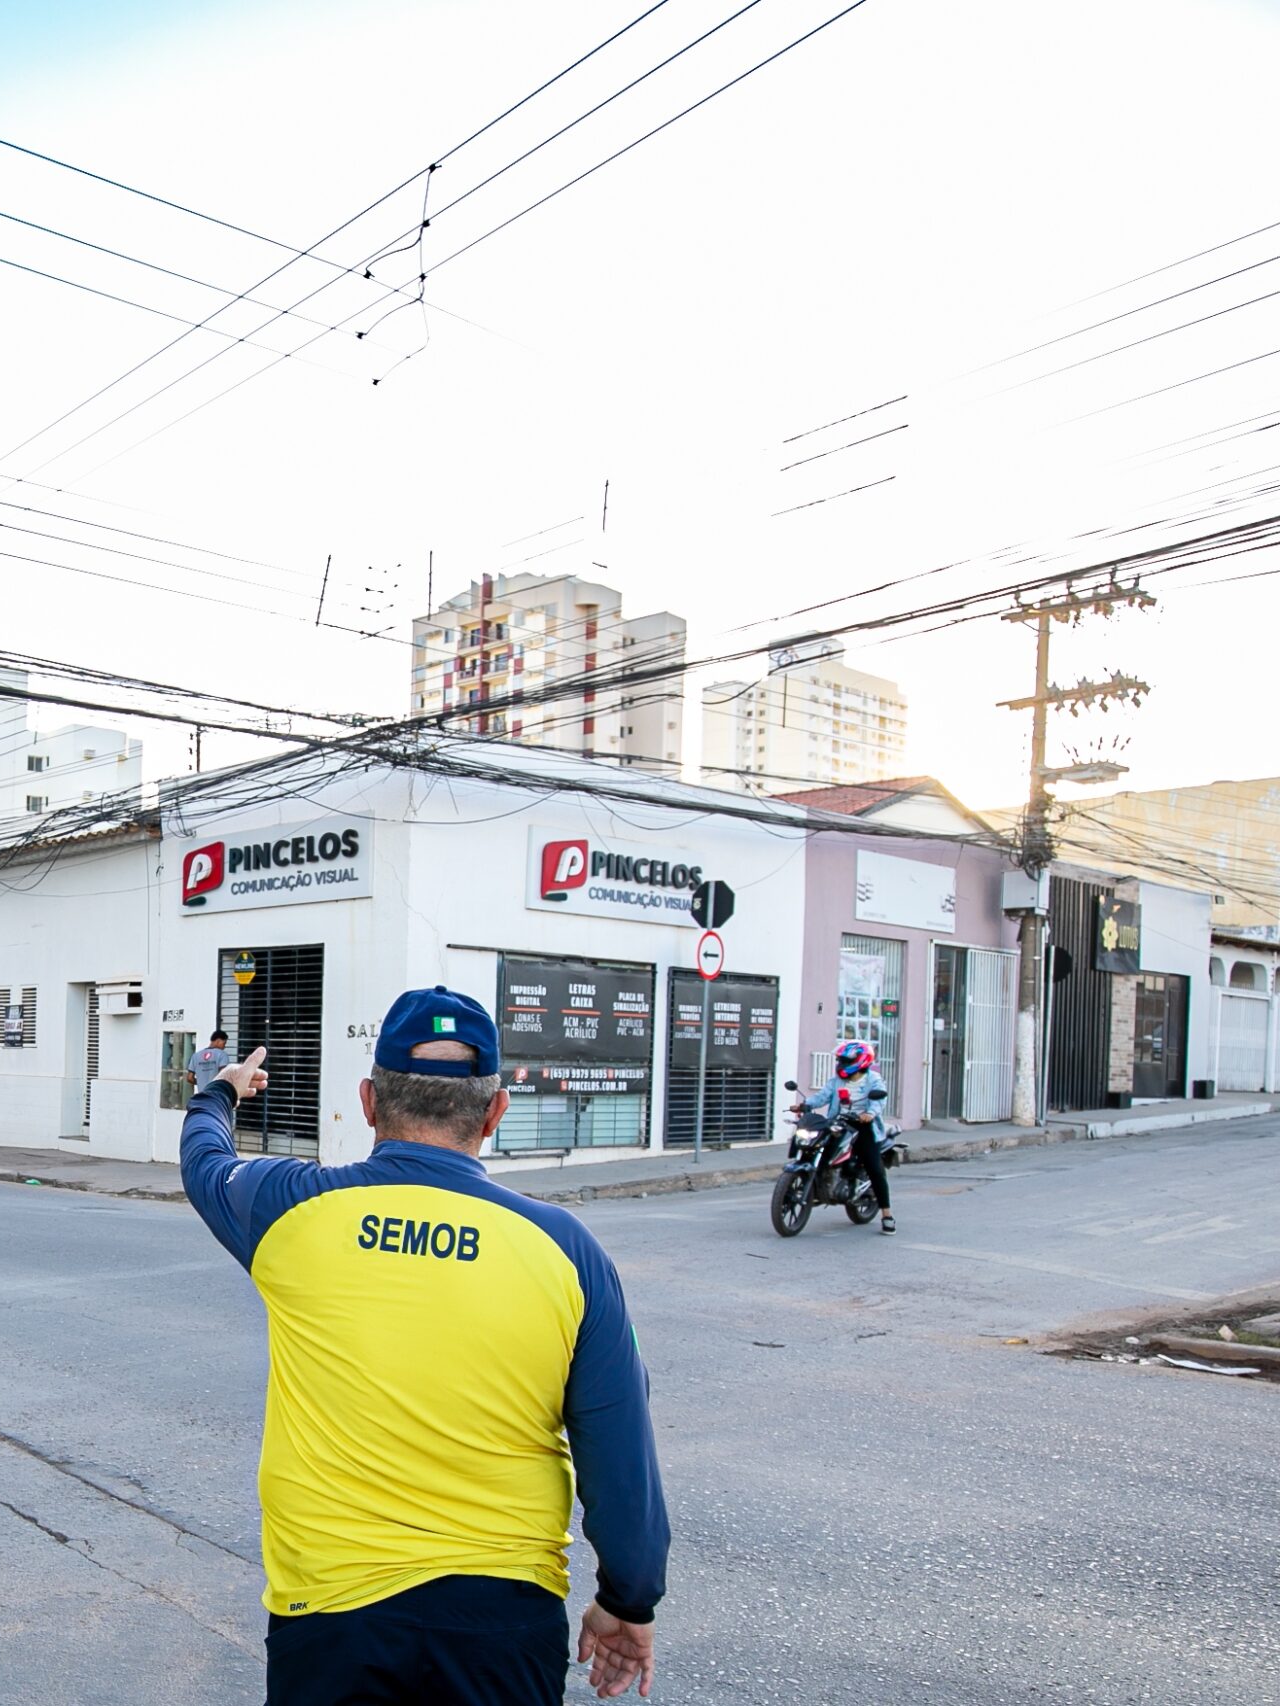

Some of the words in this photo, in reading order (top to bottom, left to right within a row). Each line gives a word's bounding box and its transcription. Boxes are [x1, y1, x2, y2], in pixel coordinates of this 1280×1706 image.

[228, 829, 360, 874] PINCELOS
[591, 850, 703, 891] PINCELOS
[231, 871, 312, 895] COMUNICAÇÃO
[314, 868, 359, 885] VISUAL
[588, 886, 662, 909] COMUNICAÇÃO
[663, 897, 692, 912] VISUA
[509, 984, 547, 996] IMPRESSÃO
[568, 983, 596, 995] LETRAS
[515, 996, 541, 1006] DIGITAL
[570, 997, 593, 1008] CAIXA
[514, 1013, 536, 1023] LONAS
[536, 1014, 541, 1023] E
[563, 1016, 579, 1027] ACM
[585, 1017, 599, 1029] PVC
[347, 1024, 378, 1038] SAL
[512, 1022, 543, 1033] ADESIVOS
[564, 1027, 597, 1039] ACRÍLICO
[571, 1069, 589, 1079] 9979
[614, 1069, 644, 1079] PINCELOS
[507, 1085, 536, 1093] PINCELOS
[568, 1081, 627, 1092] PINCELOS.COM.BR
[358, 1214, 480, 1262] SEMOB
[289, 1601, 310, 1611] BRK
